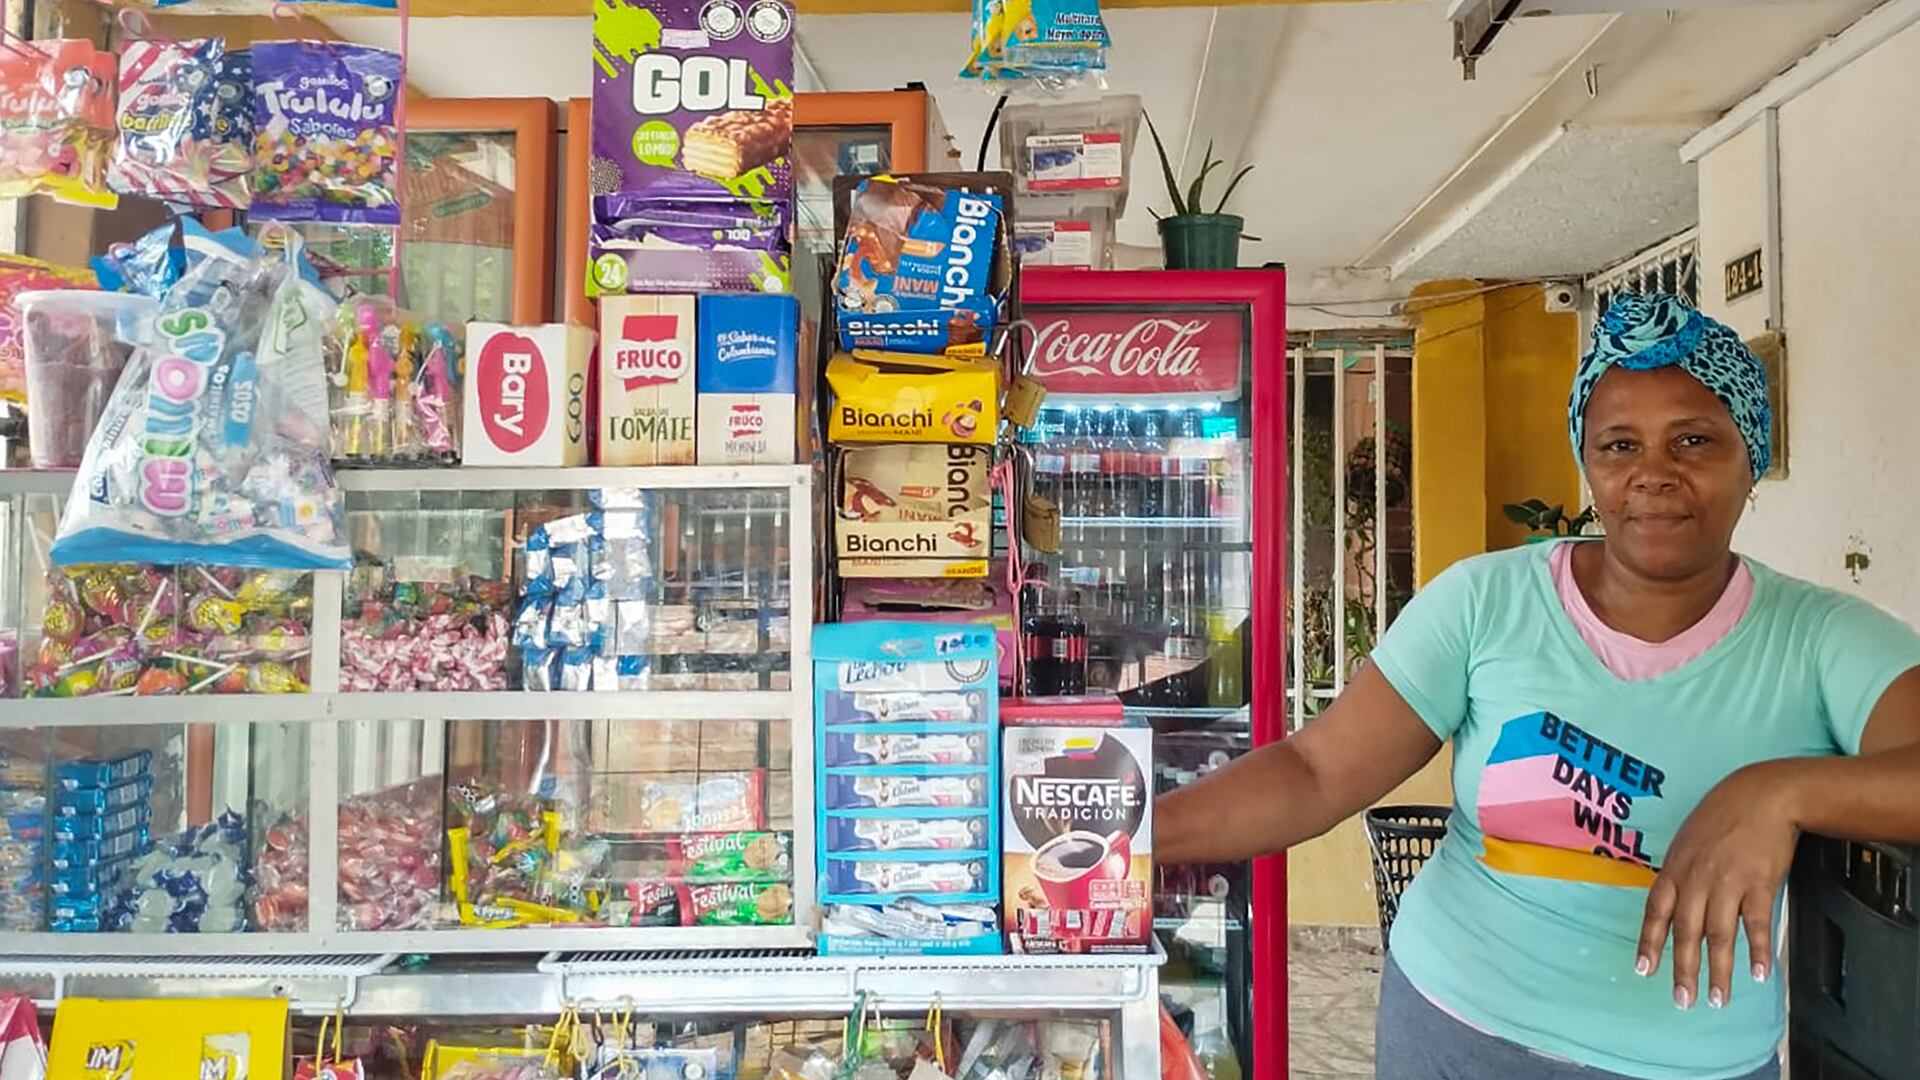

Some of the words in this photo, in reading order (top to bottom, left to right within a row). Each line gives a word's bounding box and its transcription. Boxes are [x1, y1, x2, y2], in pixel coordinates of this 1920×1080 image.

[633, 54, 765, 114] GOL
[256, 80, 385, 121] Trululu
[290, 118, 357, 139] Sabores
[940, 197, 991, 310] Bianch
[601, 263, 621, 283] 24
[848, 319, 939, 336] Bianchi
[616, 349, 681, 370] FRUCO
[1031, 318, 1211, 376] Coca-Cola
[494, 352, 532, 437] Bary
[609, 416, 692, 442] TOMATE
[728, 415, 763, 428] FRUCO
[843, 407, 932, 428] Bianchi
[947, 445, 976, 518] Bianc
[847, 534, 937, 552] Bianchi
[1540, 711, 1666, 798] BETTER
[1552, 755, 1632, 820] DAYS
[1023, 803, 1127, 820] TRADICIÓN
[681, 832, 746, 861] Festival
[1573, 800, 1652, 862] WILL
[690, 882, 754, 916] Festival
